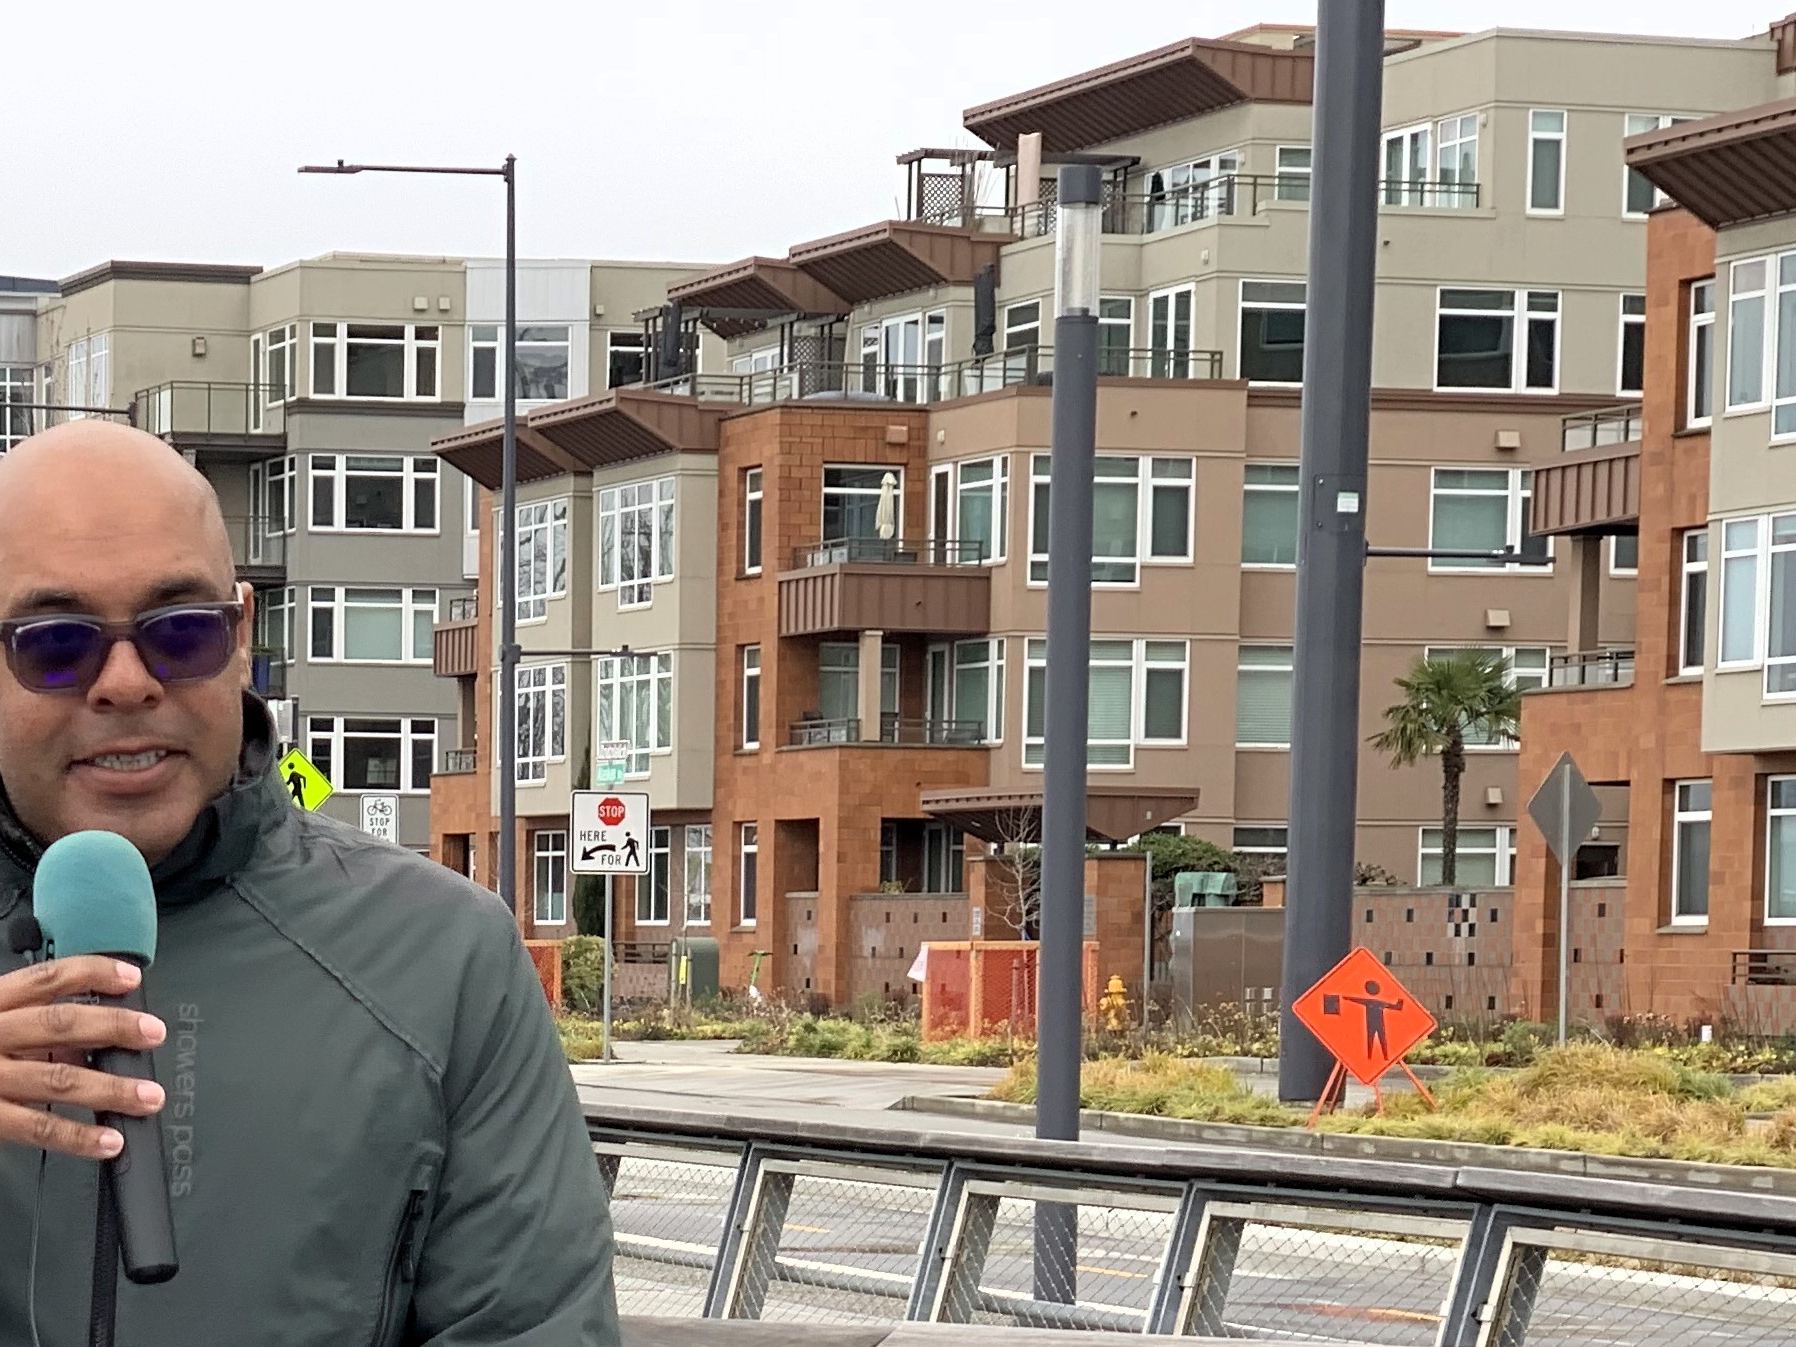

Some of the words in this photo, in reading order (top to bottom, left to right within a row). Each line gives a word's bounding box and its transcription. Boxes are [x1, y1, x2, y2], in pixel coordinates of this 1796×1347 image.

[599, 806, 624, 817] STOP
[369, 818, 390, 826] STOP
[372, 828, 388, 837] FOR
[580, 830, 607, 842] HERE
[601, 854, 621, 865] FOR
[173, 1003, 204, 1119] showers
